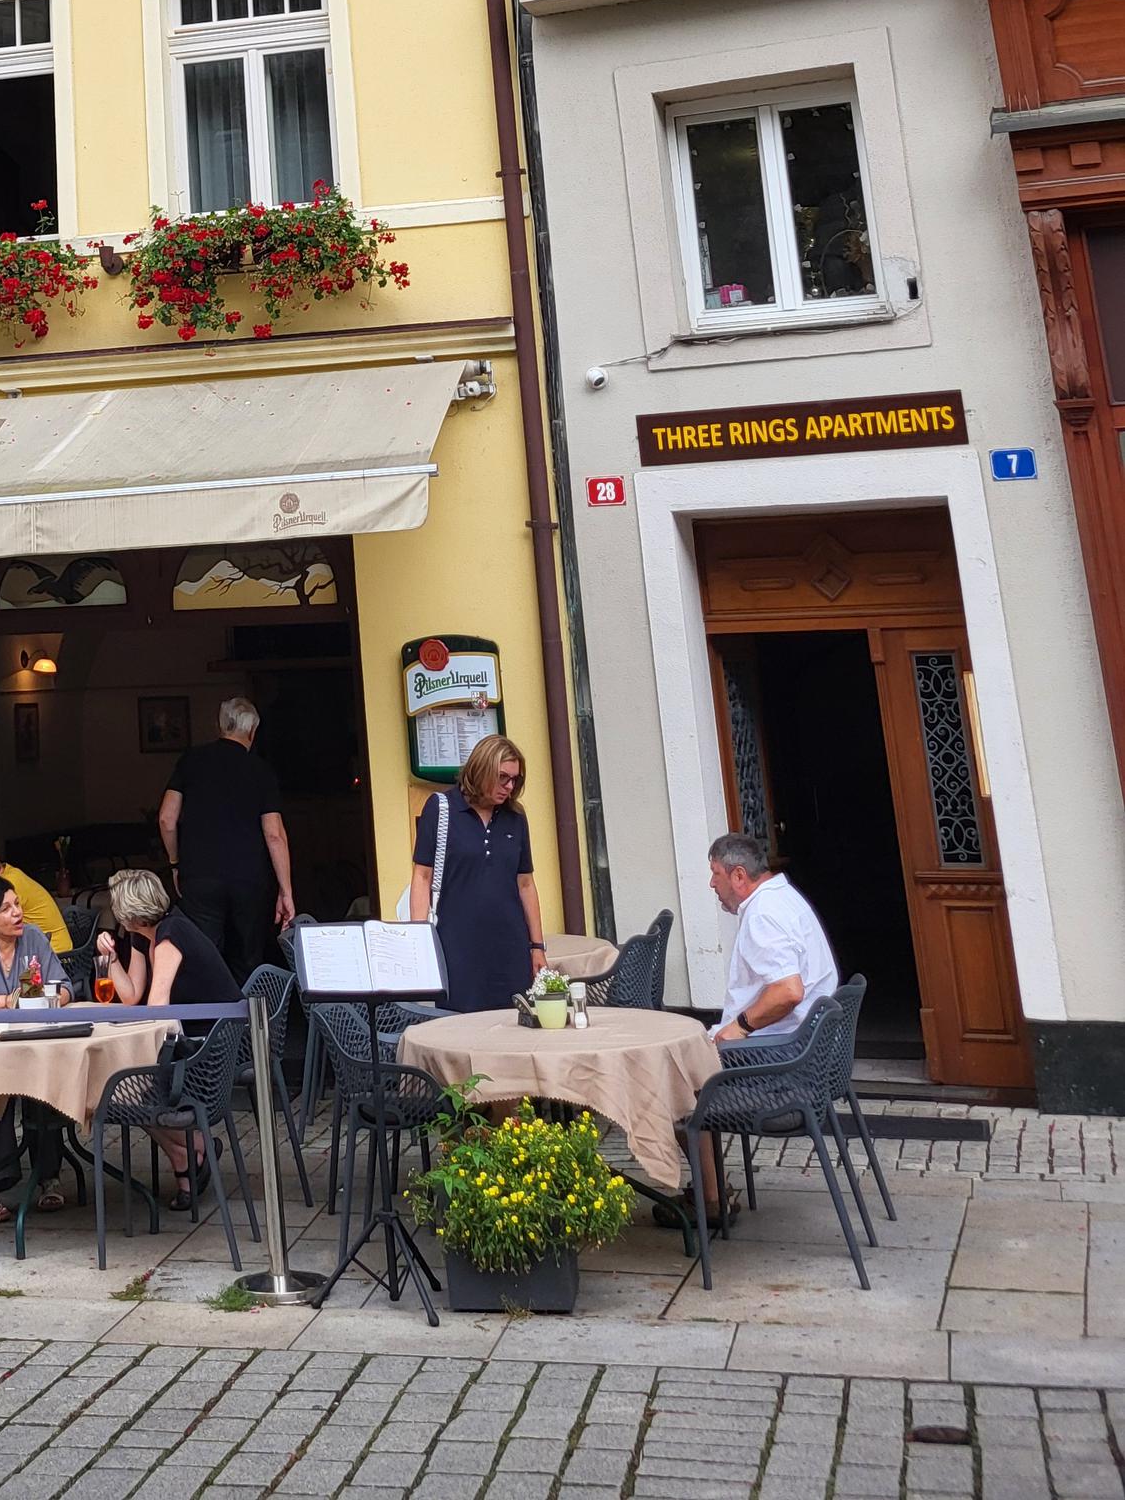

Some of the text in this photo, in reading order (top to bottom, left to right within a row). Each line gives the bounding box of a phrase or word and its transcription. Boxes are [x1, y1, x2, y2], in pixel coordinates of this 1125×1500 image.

[652, 405, 955, 452] THREE RINGS APARTMENTS
[1006, 454, 1019, 475] 7
[597, 482, 616, 501] 28
[273, 511, 326, 533] Pilsner Urquell
[414, 670, 488, 699] Pilsner Urquell
